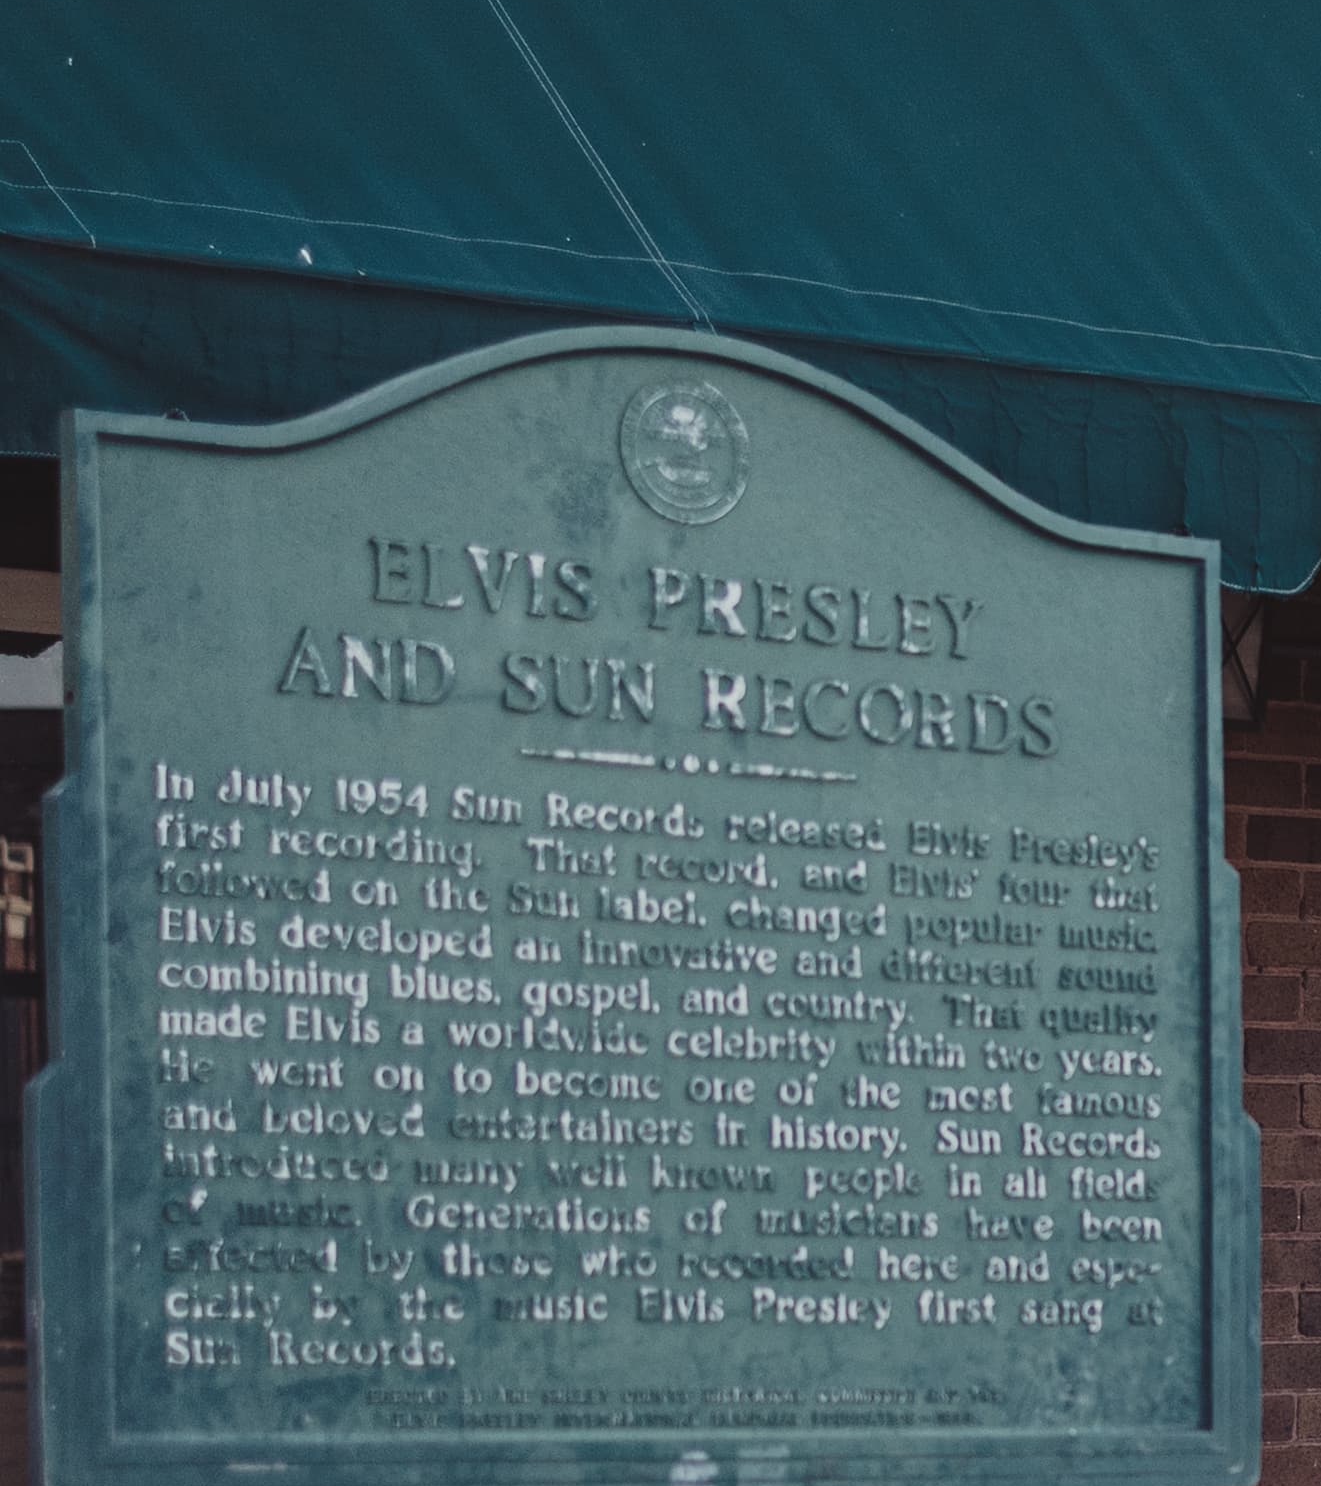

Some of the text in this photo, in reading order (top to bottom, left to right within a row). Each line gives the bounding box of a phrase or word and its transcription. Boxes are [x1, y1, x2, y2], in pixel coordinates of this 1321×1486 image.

[370, 536, 985, 660] ELVIS PRESLEY
[277, 626, 1061, 760] AND SUN RECORDS
[156, 765, 1160, 878] In July 1954 Sun Records released Elvis Presley's
[157, 814, 244, 853] first
[529, 837, 617, 877] That
[804, 854, 866, 892] and
[159, 860, 1042, 954] followed on the Sun changed popular
[160, 908, 256, 947] Elvis
[281, 914, 492, 967] developed
[515, 935, 561, 963] an
[581, 930, 777, 974] innovative
[797, 941, 862, 978] and
[159, 955, 368, 1006] combining
[683, 979, 748, 1016] and
[944, 991, 1022, 1028] That
[160, 1002, 1162, 1083] made Elvis a worldwide celebrity within two years.
[160, 1049, 1161, 1118] He went on to become one of the most famous
[163, 1097, 1161, 1158] and beloved entertainers in history. Sun Records
[414, 1159, 522, 1194] many
[806, 1158, 922, 1202] people
[950, 1161, 982, 1196] in
[1005, 1162, 1047, 1197] all
[408, 1195, 1162, 1240] Generations of musicians have been
[364, 1240, 414, 1283] by
[442, 1241, 553, 1276] those
[580, 1242, 657, 1277] who
[879, 1245, 959, 1280] here
[987, 1246, 1049, 1281] and
[1071, 1256, 1162, 1290] espe-
[401, 1286, 465, 1321] the
[494, 1287, 608, 1321] music
[637, 1287, 724, 1322] Elvis
[752, 1288, 892, 1331] Presley
[918, 1289, 996, 1323] first
[1021, 1298, 1104, 1332] sang
[166, 1331, 456, 1366] Sun Records.
